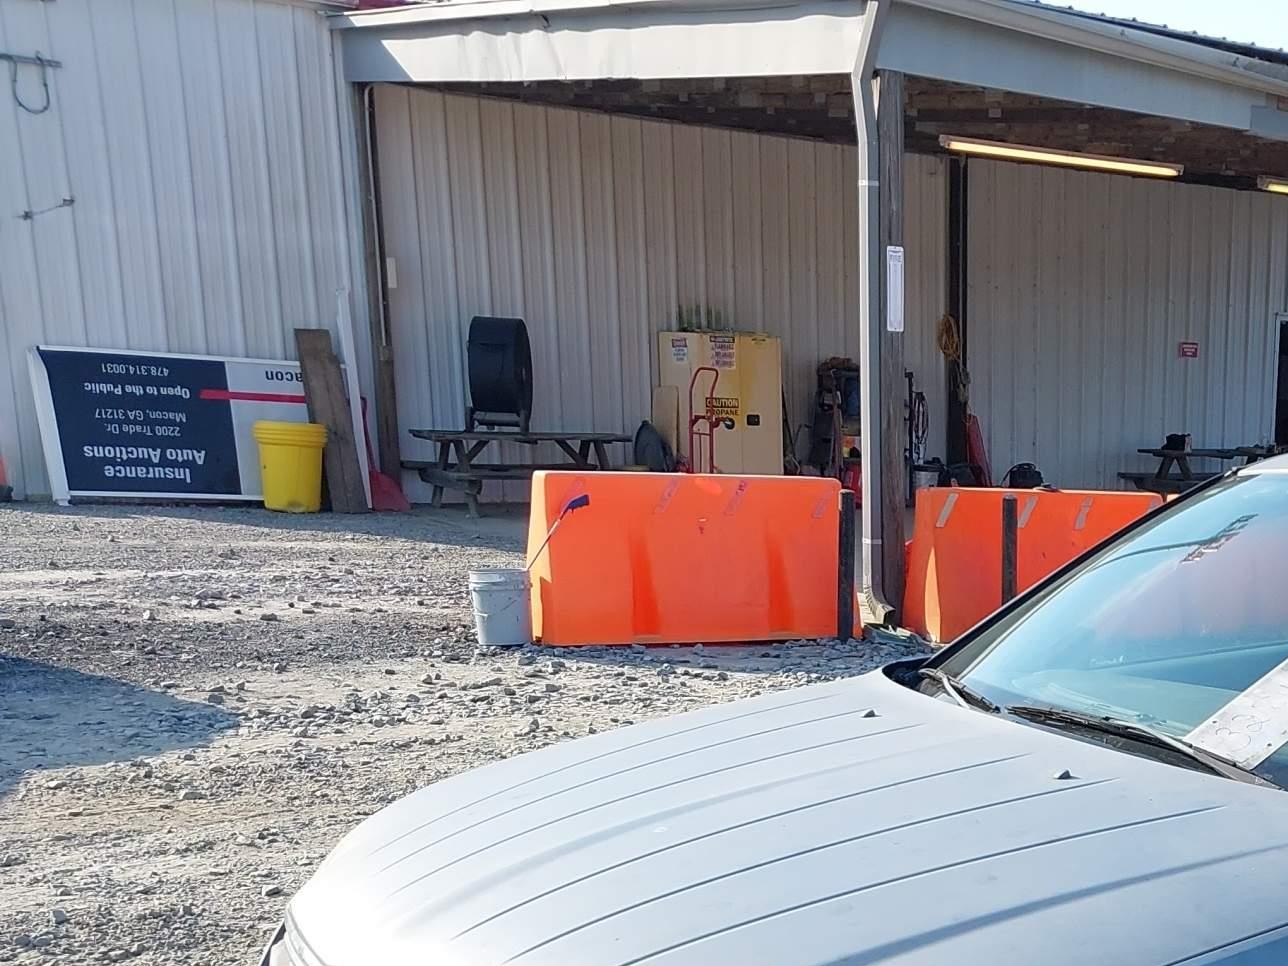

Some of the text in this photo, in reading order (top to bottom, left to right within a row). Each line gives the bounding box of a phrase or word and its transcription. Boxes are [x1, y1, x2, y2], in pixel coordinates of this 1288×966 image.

[101, 362, 169, 377] 478.314.0031
[265, 370, 304, 383] acon
[83, 381, 190, 399] Open to the Public
[95, 408, 187, 423] Macon, GA 31217
[104, 422, 181, 437] 2200 Trade Dr.
[83, 445, 206, 465] Auto Auctions
[104, 465, 192, 483] Insurance
